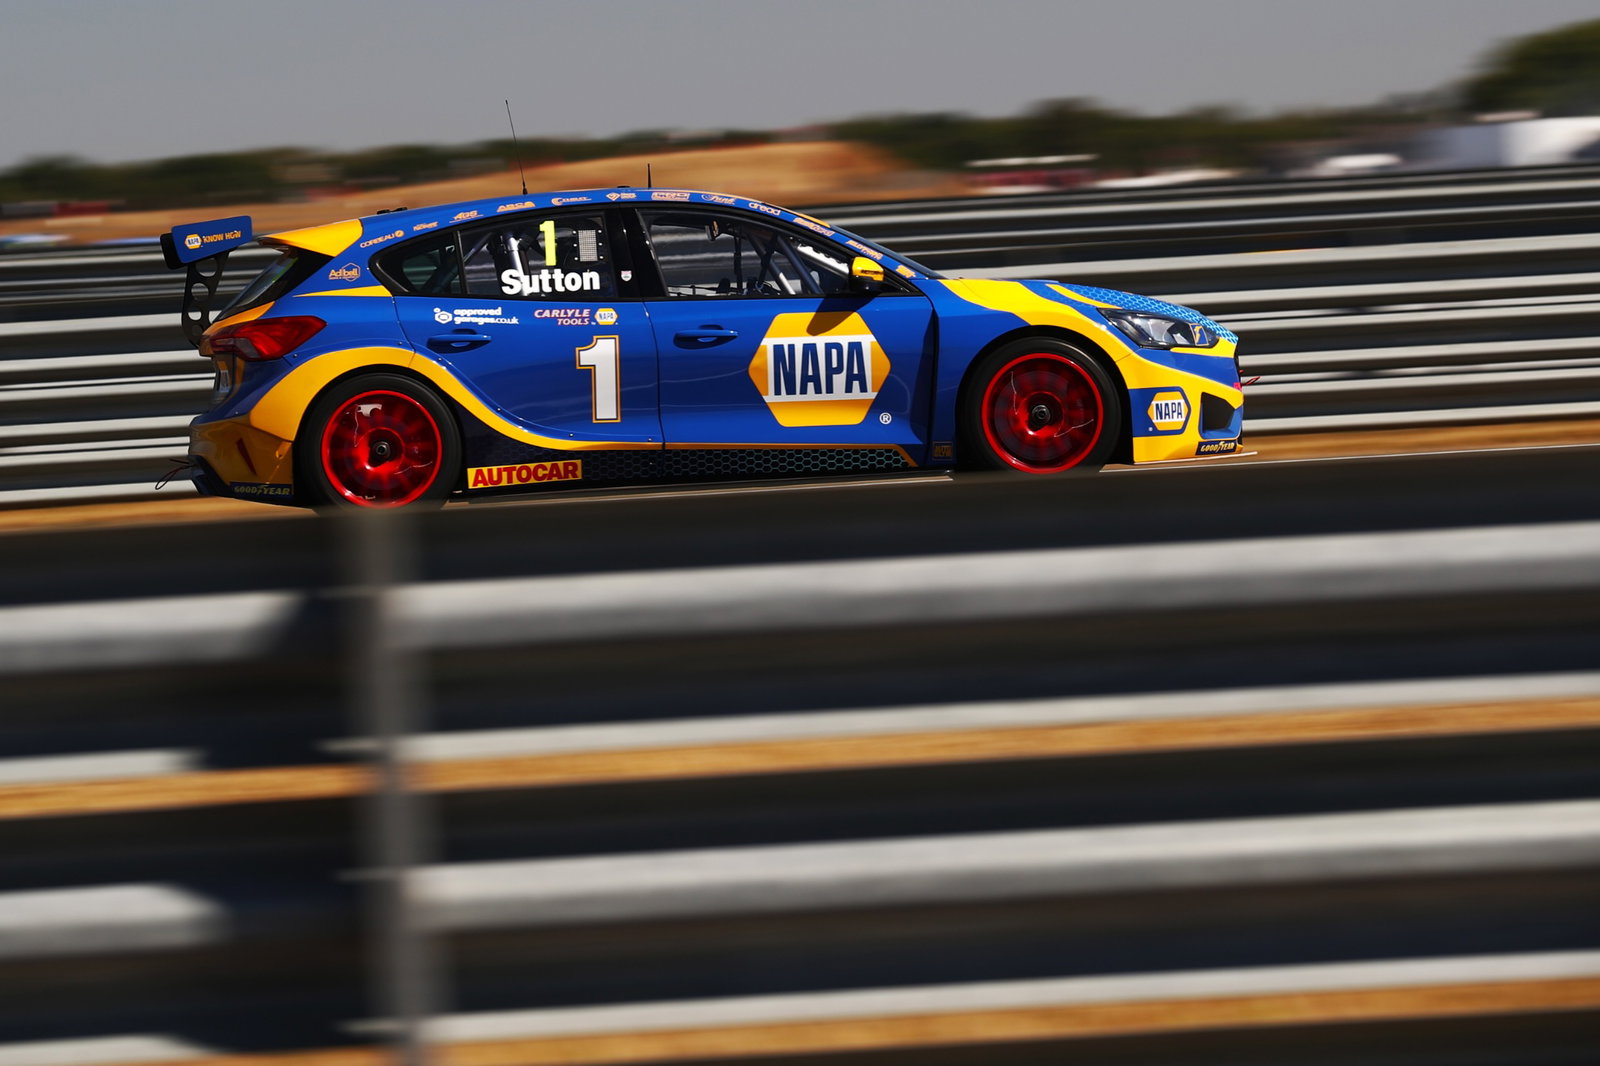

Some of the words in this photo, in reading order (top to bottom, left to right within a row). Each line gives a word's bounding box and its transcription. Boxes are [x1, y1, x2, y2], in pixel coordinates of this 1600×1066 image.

[203, 234, 224, 243] KNOW
[225, 231, 242, 240] HOW
[539, 220, 557, 266] 1
[501, 268, 600, 295] Sutton
[453, 306, 502, 317] approved
[534, 308, 591, 318] CARLYLE
[557, 318, 590, 326] TOOLS
[773, 341, 868, 396] NAPA
[575, 335, 621, 424] 1
[1155, 402, 1183, 420] NAPA
[472, 461, 579, 487] AUTOCAR
[234, 485, 290, 496] GOODYEAR
